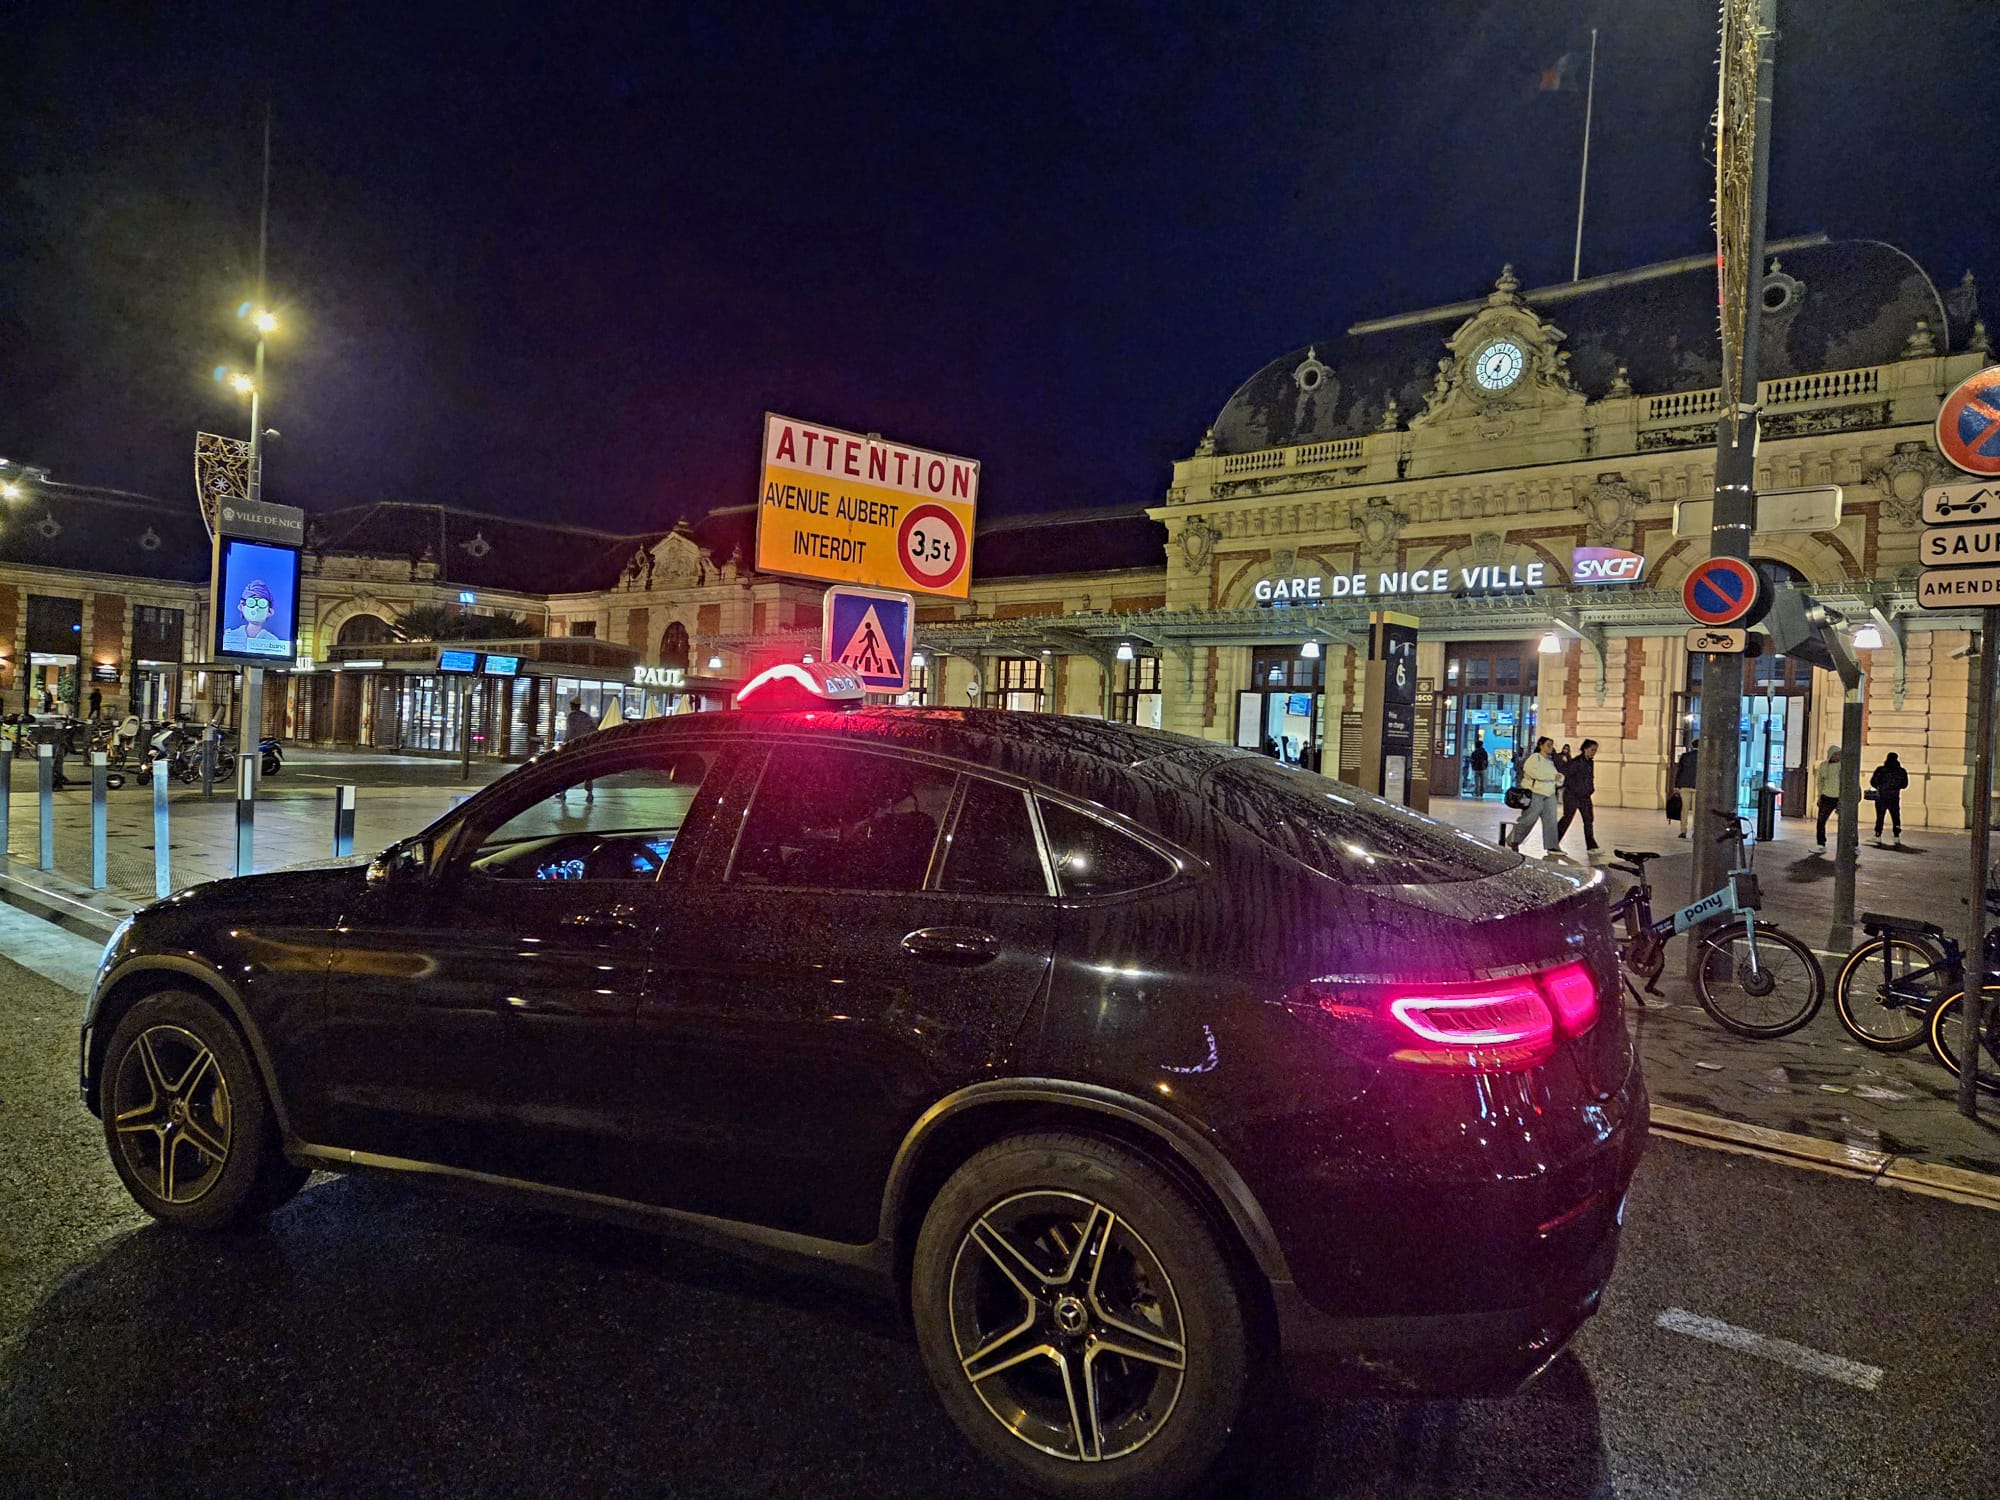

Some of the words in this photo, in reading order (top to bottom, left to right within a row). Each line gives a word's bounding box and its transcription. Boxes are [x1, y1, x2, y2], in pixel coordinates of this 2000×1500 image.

[776, 426, 970, 498] ATTENTION
[764, 482, 830, 516] AVENUE
[836, 496, 899, 528] AUBERT
[236, 511, 262, 523] VILLE
[264, 516, 278, 525] DE
[279, 519, 303, 530] NICE
[793, 530, 867, 564] INTERDIT
[1574, 557, 1637, 577] SNCF
[1255, 577, 1321, 600] GARE
[1332, 574, 1366, 596] DE
[1379, 569, 1449, 593] NICE
[1461, 563, 1544, 588] VILLE
[633, 666, 686, 687] PAUL
[1415, 694, 1433, 702] SCO
[1684, 895, 1723, 922] pony
